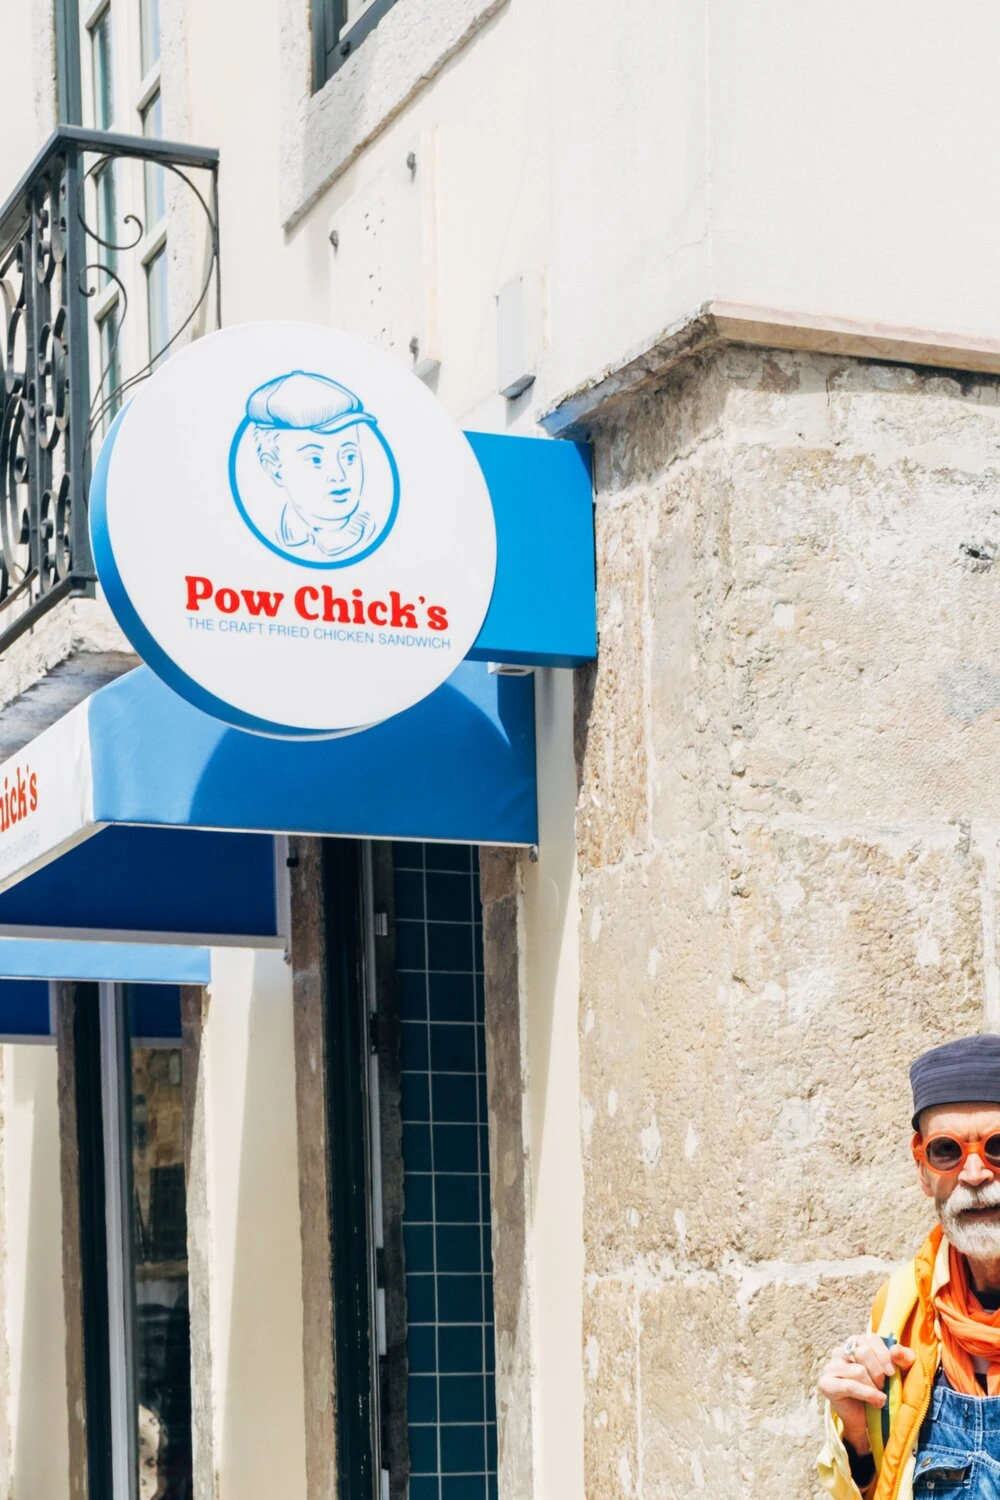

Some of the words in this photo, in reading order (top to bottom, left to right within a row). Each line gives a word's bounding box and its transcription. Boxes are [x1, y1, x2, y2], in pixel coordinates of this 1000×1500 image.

[185, 575, 284, 617] Pow
[294, 584, 449, 631] Chick's
[186, 616, 216, 631] THE
[218, 619, 265, 635] CRAFT
[268, 623, 310, 639] FRIED
[313, 627, 374, 643] CHICKEN
[378, 632, 451, 650] SANDWICH
